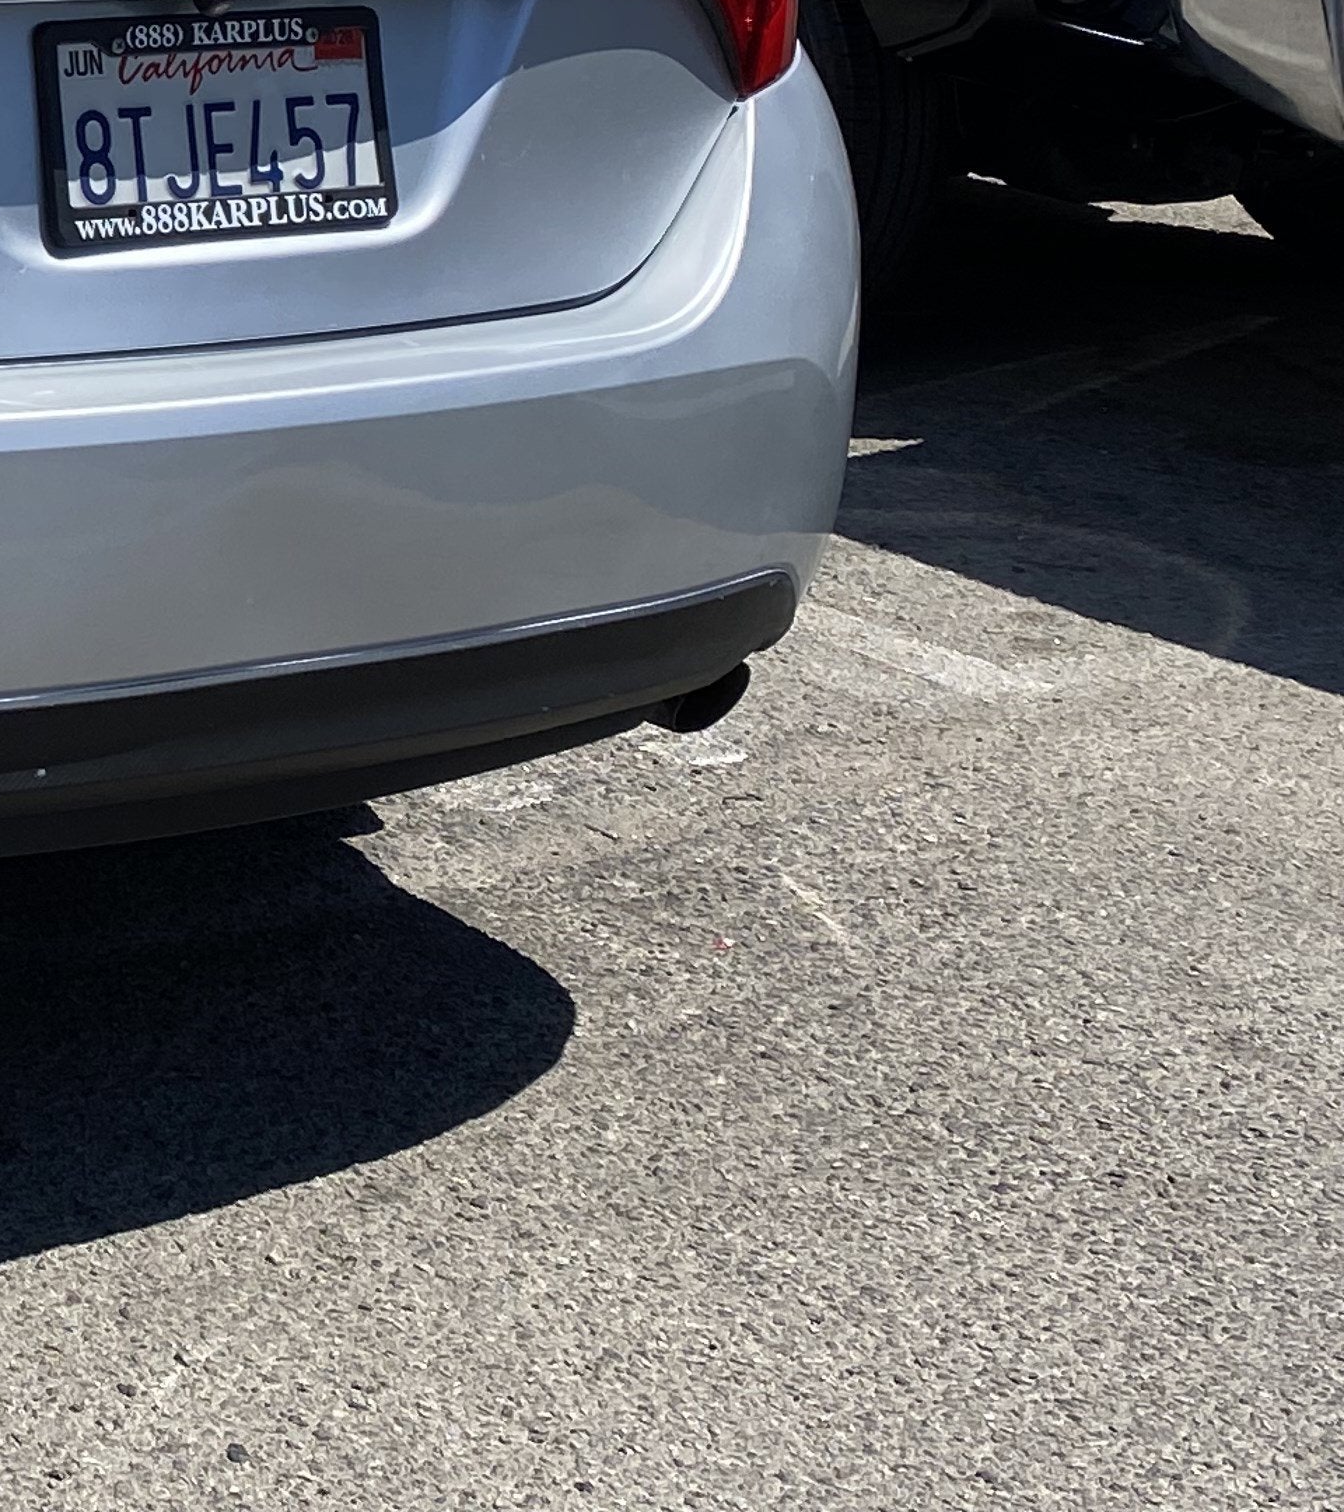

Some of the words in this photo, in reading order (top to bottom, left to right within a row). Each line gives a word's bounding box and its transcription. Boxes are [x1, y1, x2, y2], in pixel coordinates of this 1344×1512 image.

[125, 23, 184, 49] (888)
[192, 18, 304, 45] KARPLUS
[63, 50, 103, 77] JUN
[118, 44, 318, 95] California
[75, 93, 359, 205] 8TJE457
